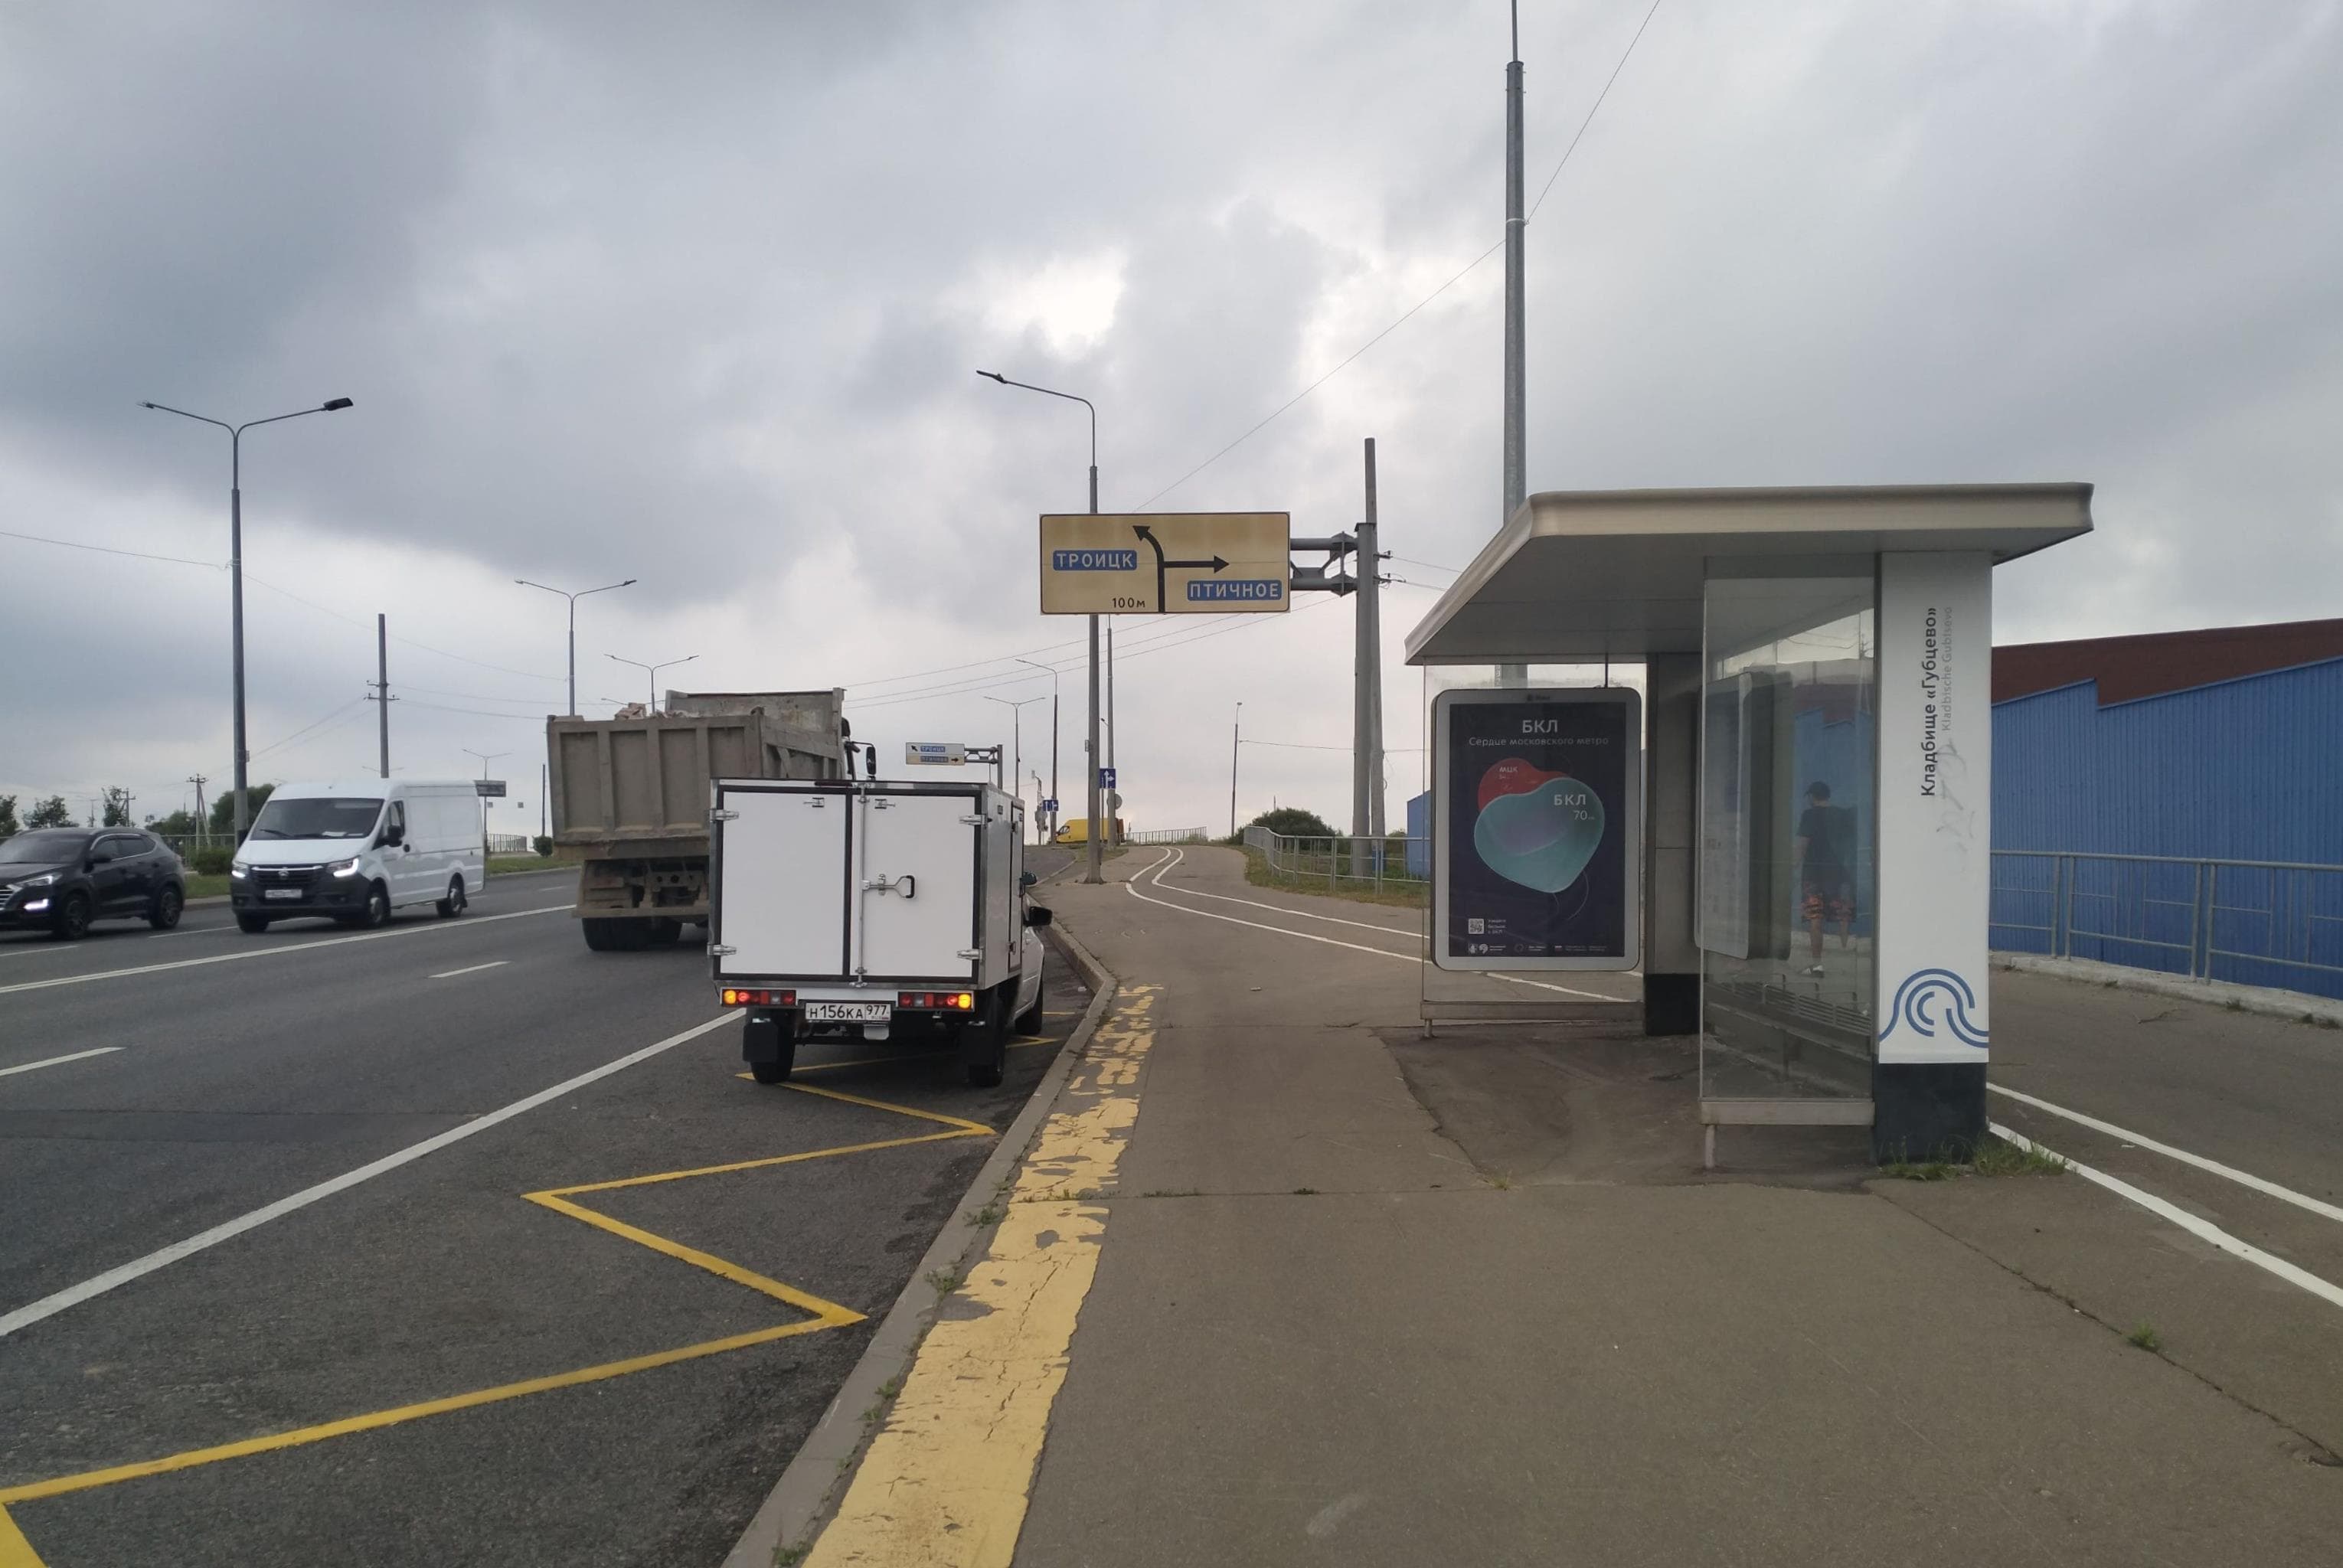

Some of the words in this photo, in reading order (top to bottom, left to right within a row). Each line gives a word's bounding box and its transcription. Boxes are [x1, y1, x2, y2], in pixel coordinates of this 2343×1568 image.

[1056, 553, 1134, 570] ТРОИЦК
[1189, 583, 1279, 599] ПТИЧНОЕ
[1921, 607, 1939, 699] «Губцево»
[1941, 665, 1952, 731] Kladbische
[1521, 719, 1559, 733] БКЛ
[1468, 737, 1507, 748] Сердце
[1509, 737, 1574, 746] московского
[1576, 737, 1609, 746] метро
[1920, 704, 1938, 797] Кладбище
[1553, 793, 1587, 806] БКЛ
[1573, 809, 1588, 821] 70
[866, 1004, 887, 1016] 977
